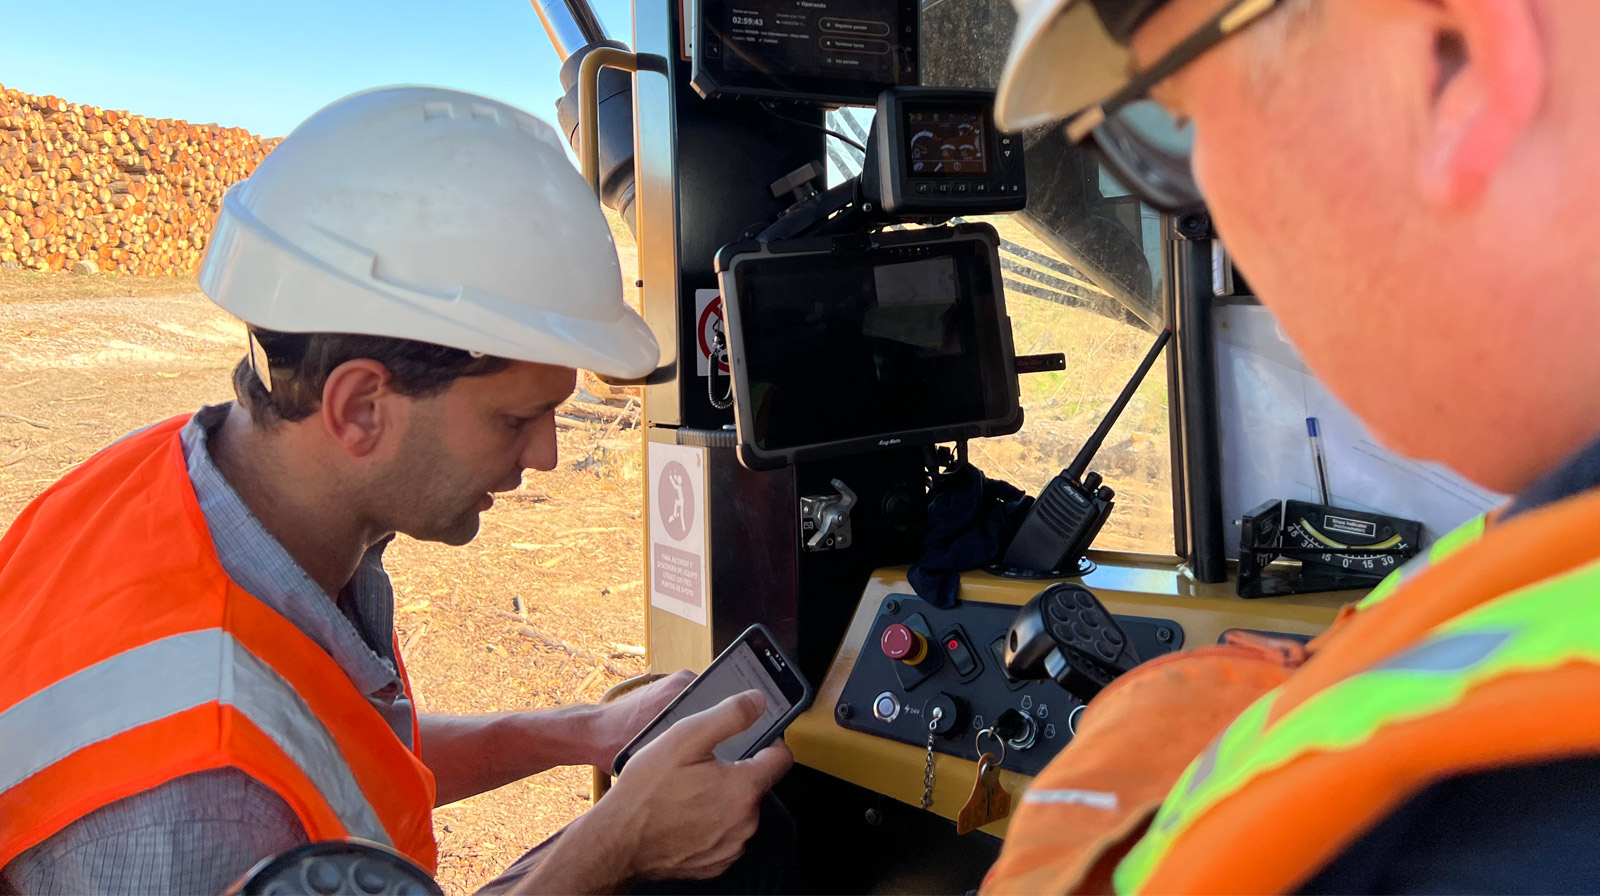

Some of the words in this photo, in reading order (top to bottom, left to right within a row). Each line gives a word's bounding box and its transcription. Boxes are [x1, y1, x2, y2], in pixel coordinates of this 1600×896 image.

[732, 16, 764, 26] 02:59:43
[1287, 526, 1299, 537] 45
[1362, 560, 1373, 568] 15
[1381, 556, 1394, 566] 30
[657, 560, 676, 572] DESCENDER
[662, 580, 675, 590] PUNTOS
